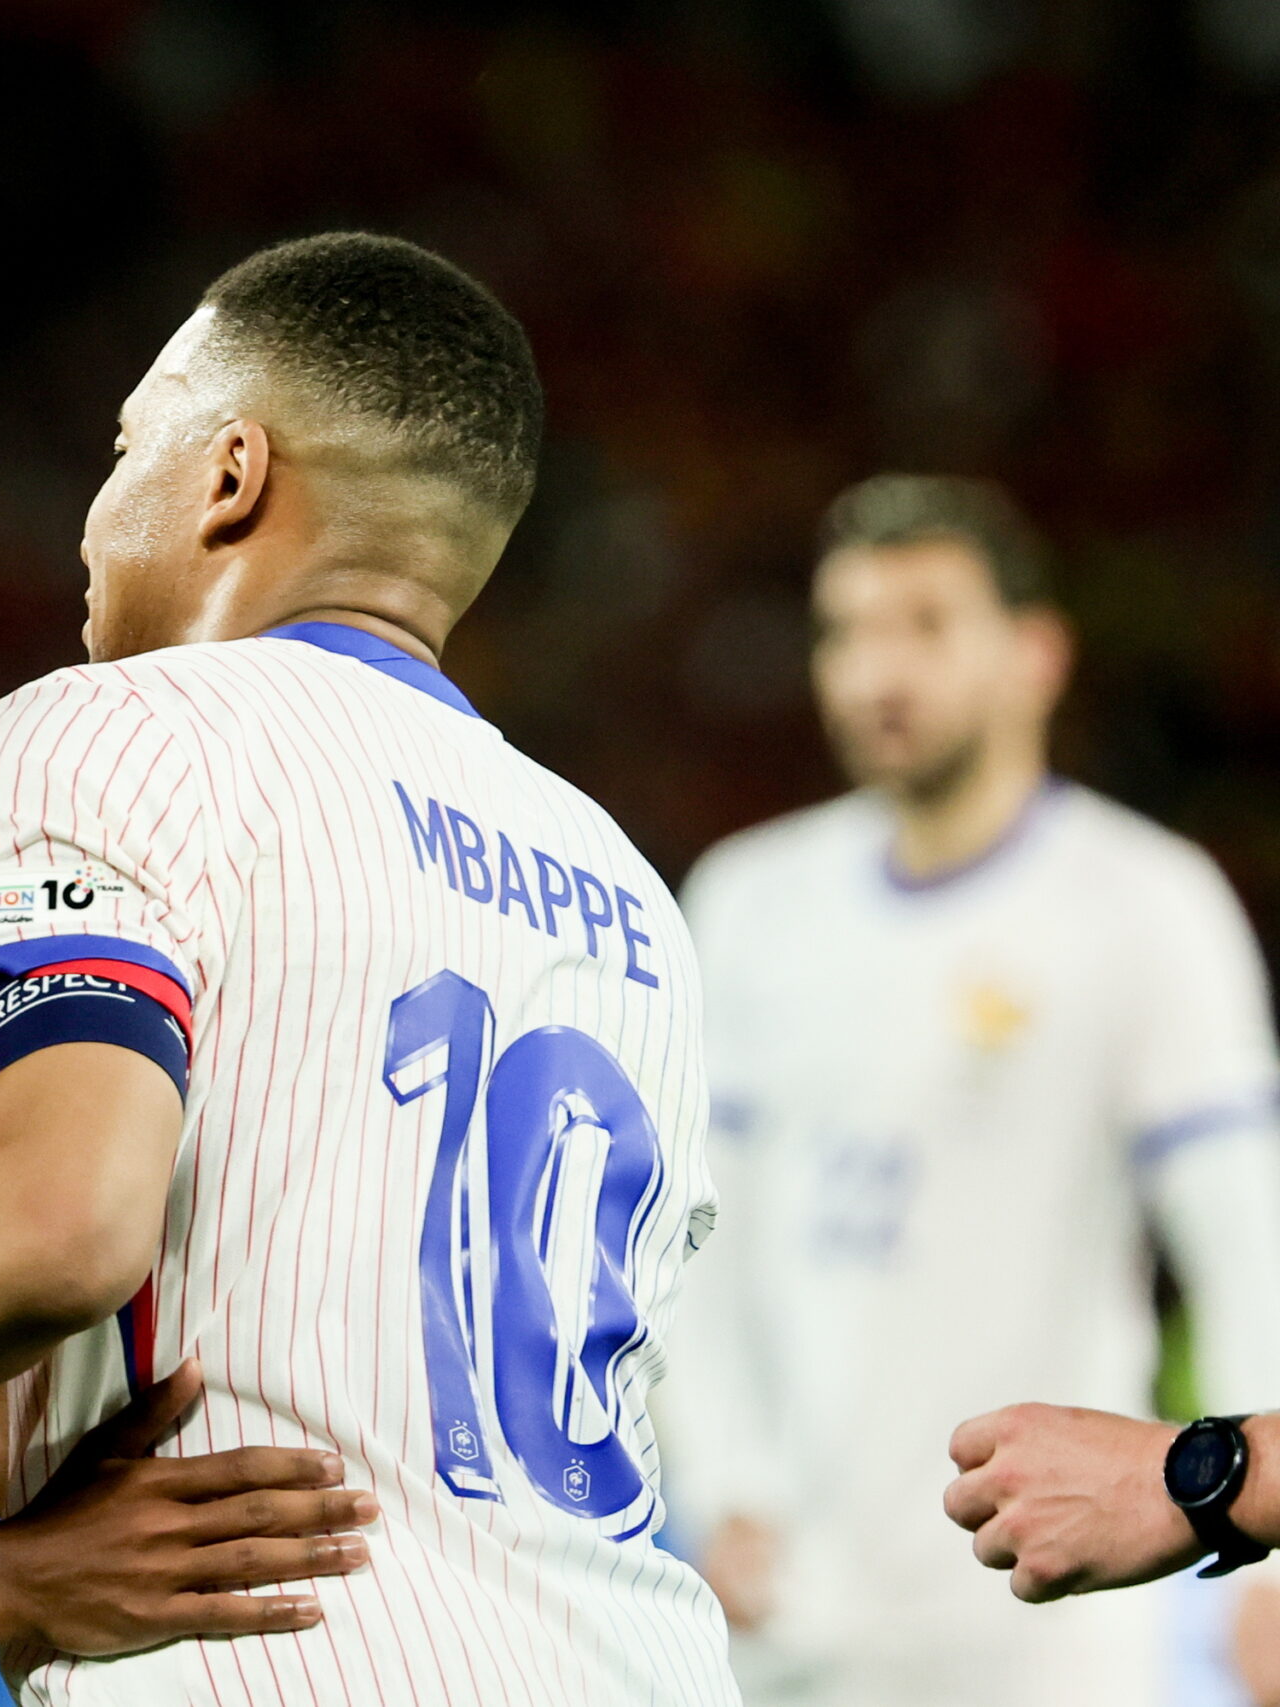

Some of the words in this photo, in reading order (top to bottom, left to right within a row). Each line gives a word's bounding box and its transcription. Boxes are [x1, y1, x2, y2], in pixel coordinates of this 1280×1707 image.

[40, 880, 95, 910] 10
[391, 779, 660, 990] MBAPPE
[382, 968, 664, 1543] 10
